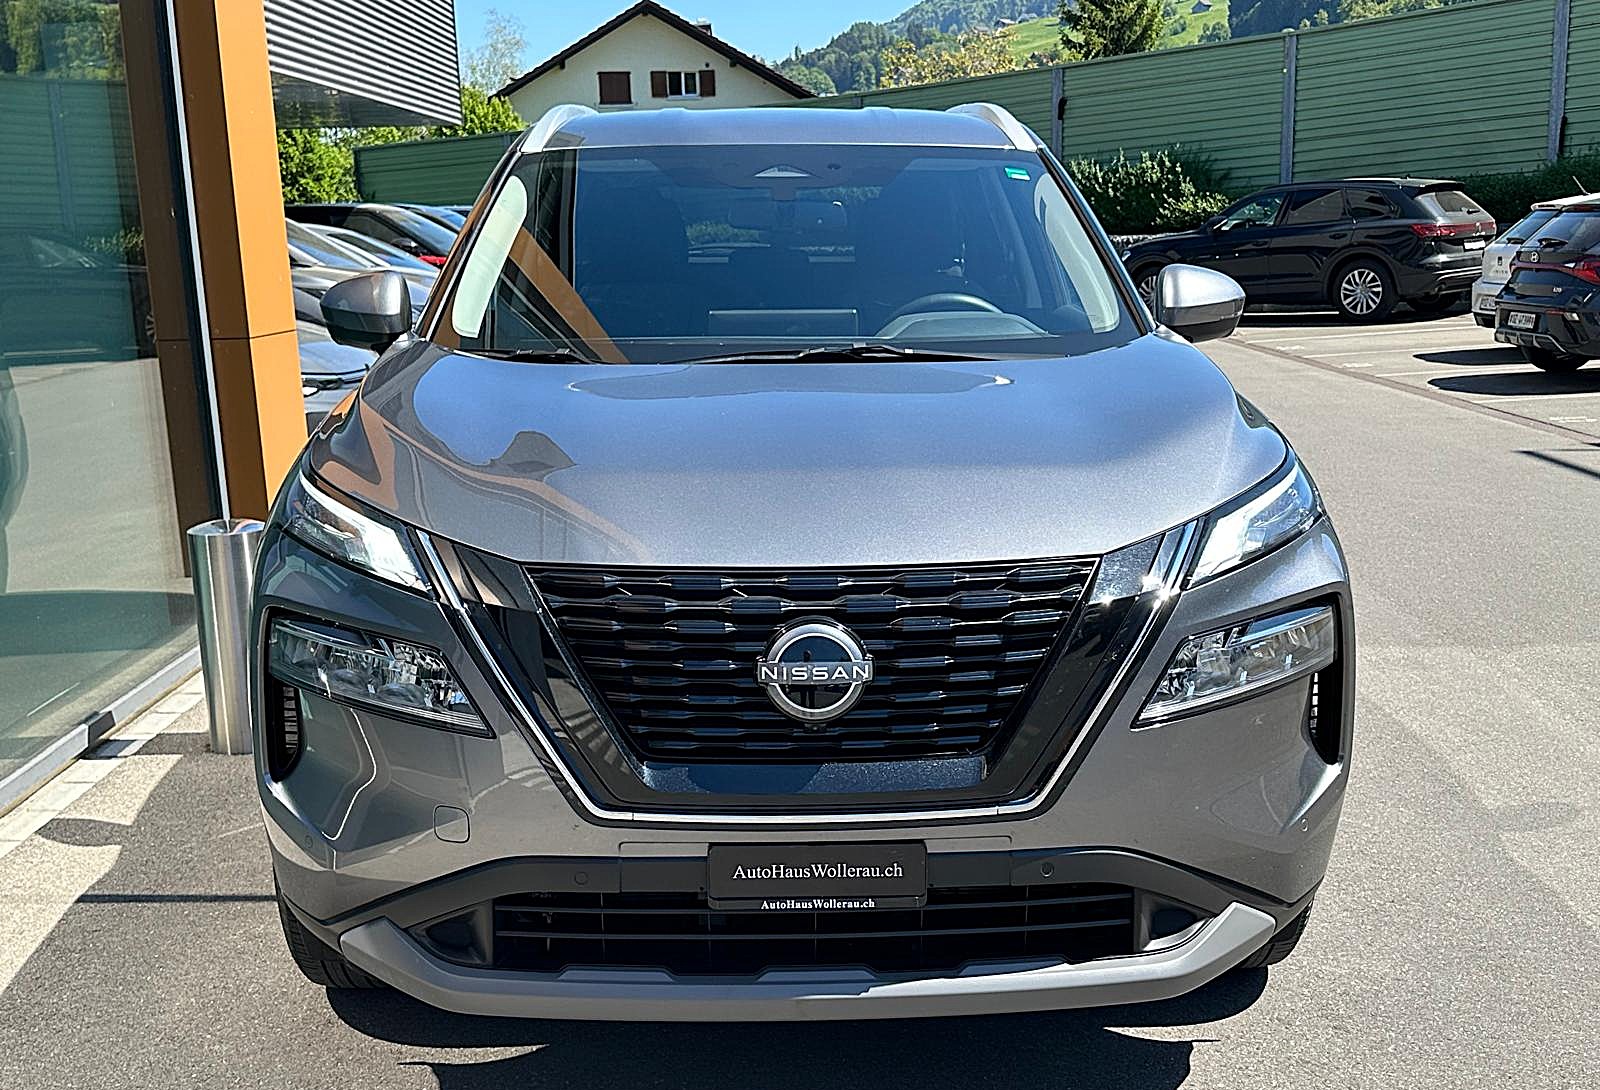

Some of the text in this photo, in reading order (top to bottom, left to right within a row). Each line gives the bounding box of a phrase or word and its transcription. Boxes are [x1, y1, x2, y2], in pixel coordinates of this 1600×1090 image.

[761, 664, 869, 681] NISSAN
[732, 863, 904, 880] AutoHausWollerau.ch
[760, 898, 876, 910] AutoHausWollerau.ch
